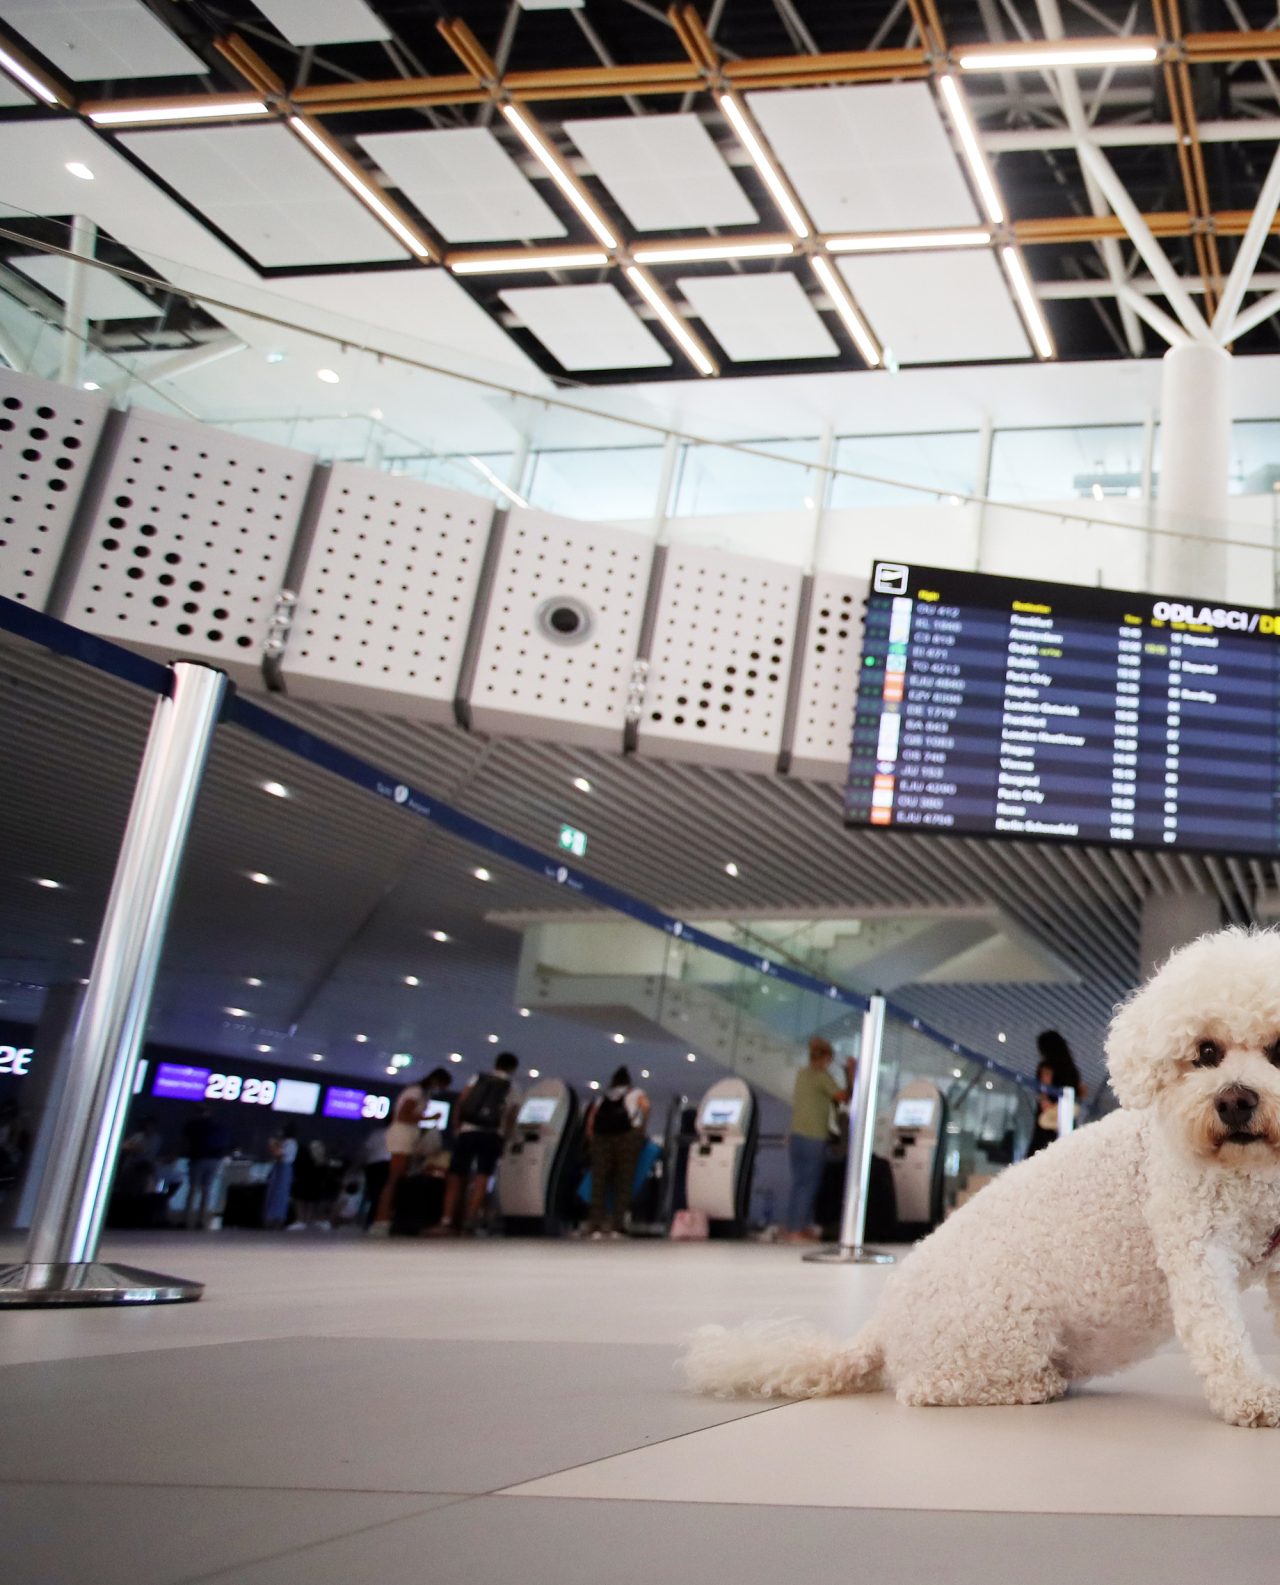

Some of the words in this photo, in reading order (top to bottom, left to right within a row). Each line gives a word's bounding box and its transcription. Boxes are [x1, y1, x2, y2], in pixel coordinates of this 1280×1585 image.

[204, 1074, 242, 1101] 28
[240, 1078, 277, 1106] 29
[361, 1094, 391, 1120] 30
